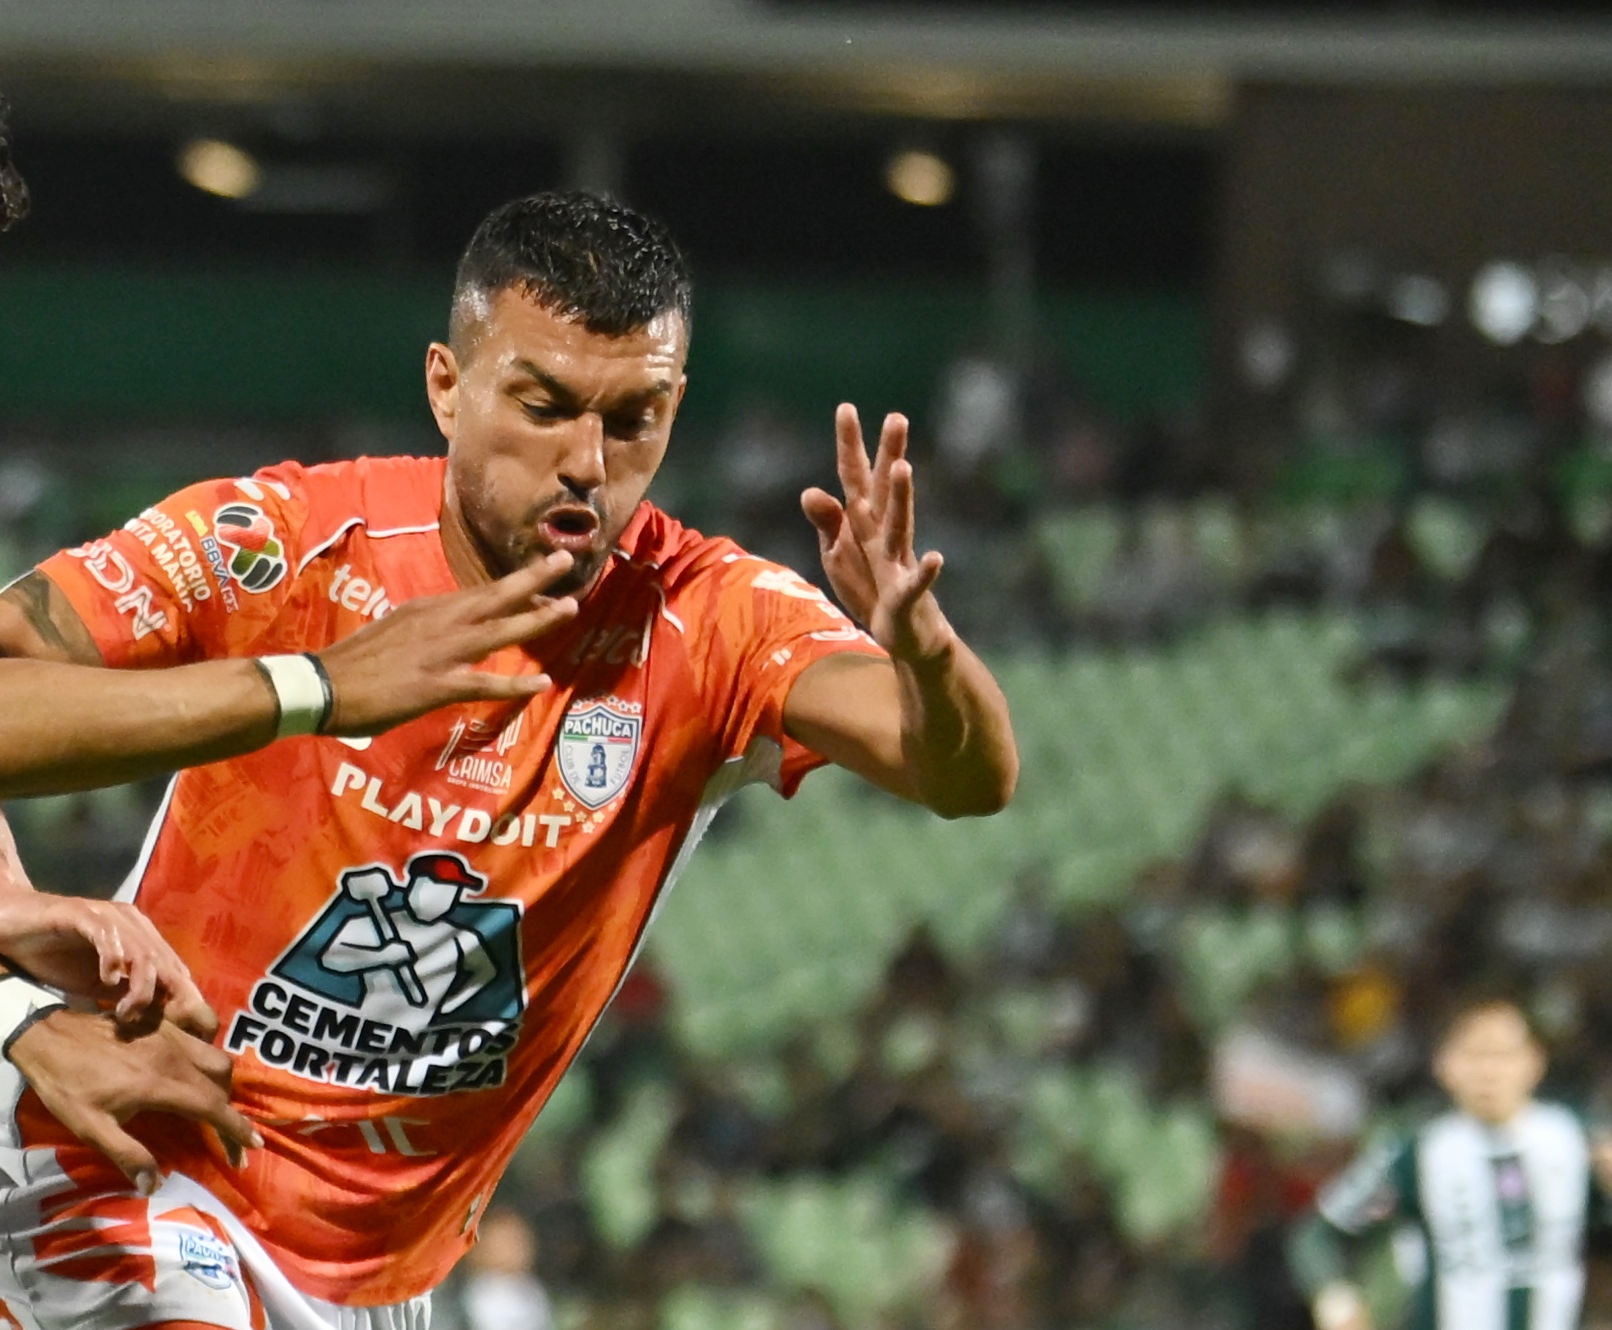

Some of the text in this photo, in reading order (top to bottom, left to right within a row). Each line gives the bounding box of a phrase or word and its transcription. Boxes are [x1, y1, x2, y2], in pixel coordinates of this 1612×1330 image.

[200, 537, 232, 590] BBVA
[564, 716, 632, 737] PACHUCA
[448, 755, 512, 789] CRIMSA
[331, 763, 571, 848] PLAYDOIT
[252, 982, 519, 1060] CEMENTOS
[228, 1014, 505, 1094] FORTALEZA
